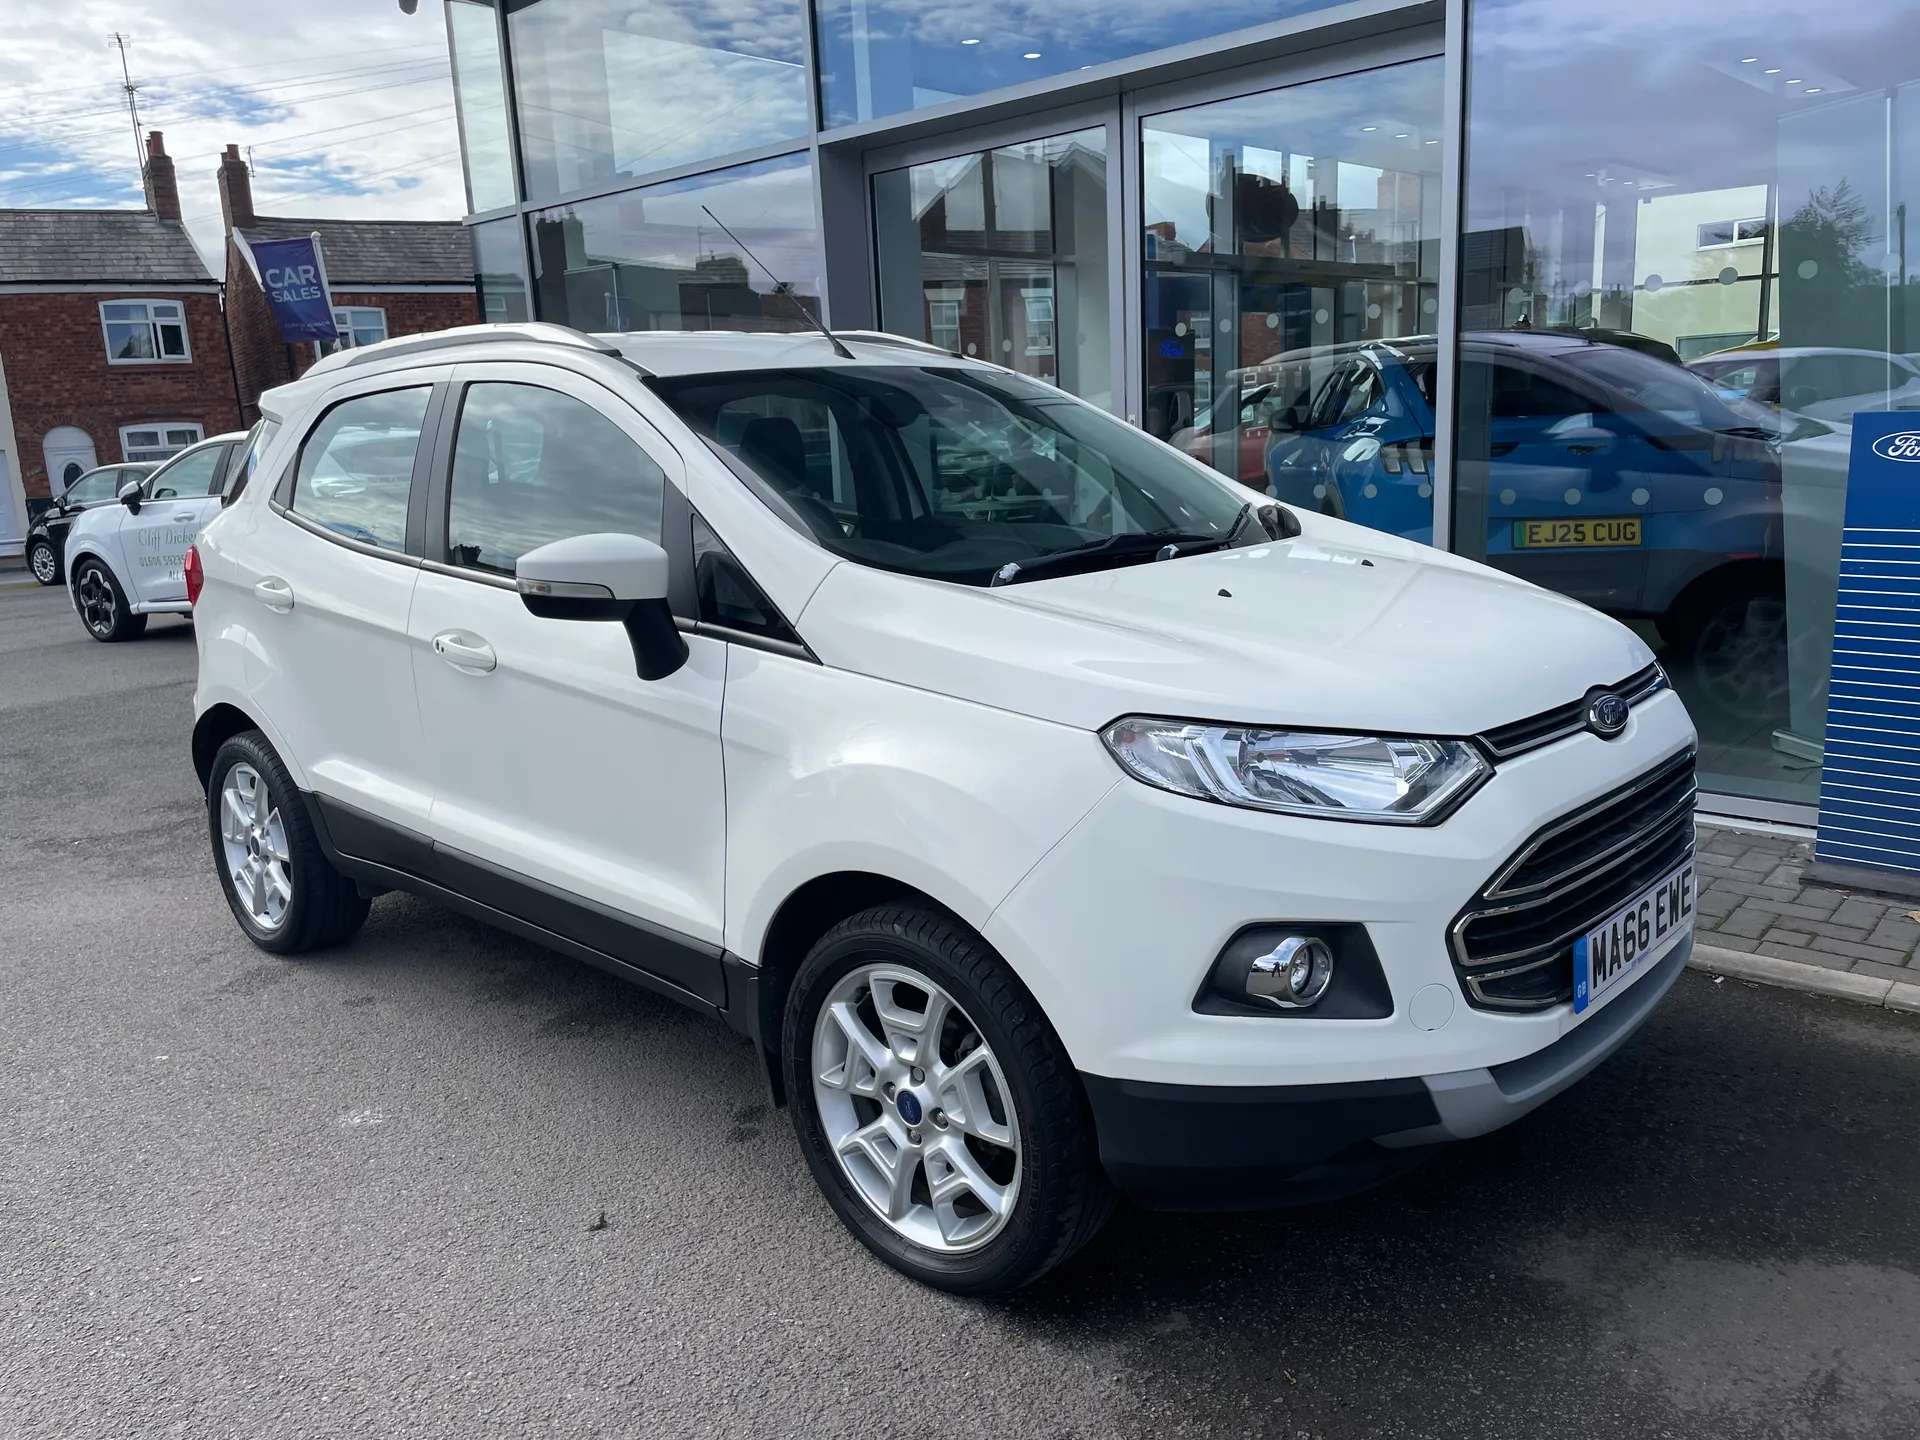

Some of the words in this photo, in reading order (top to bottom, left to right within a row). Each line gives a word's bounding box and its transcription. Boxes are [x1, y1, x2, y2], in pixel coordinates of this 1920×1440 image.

[265, 265, 316, 289] CAR
[271, 286, 321, 303] SALES
[1888, 435, 1920, 457] Fo
[137, 527, 160, 552] Cliff
[1528, 523, 1587, 544] EJ25
[1592, 521, 1637, 543] CUG
[1592, 900, 1650, 990] MA66
[1655, 866, 1693, 940] EWE
